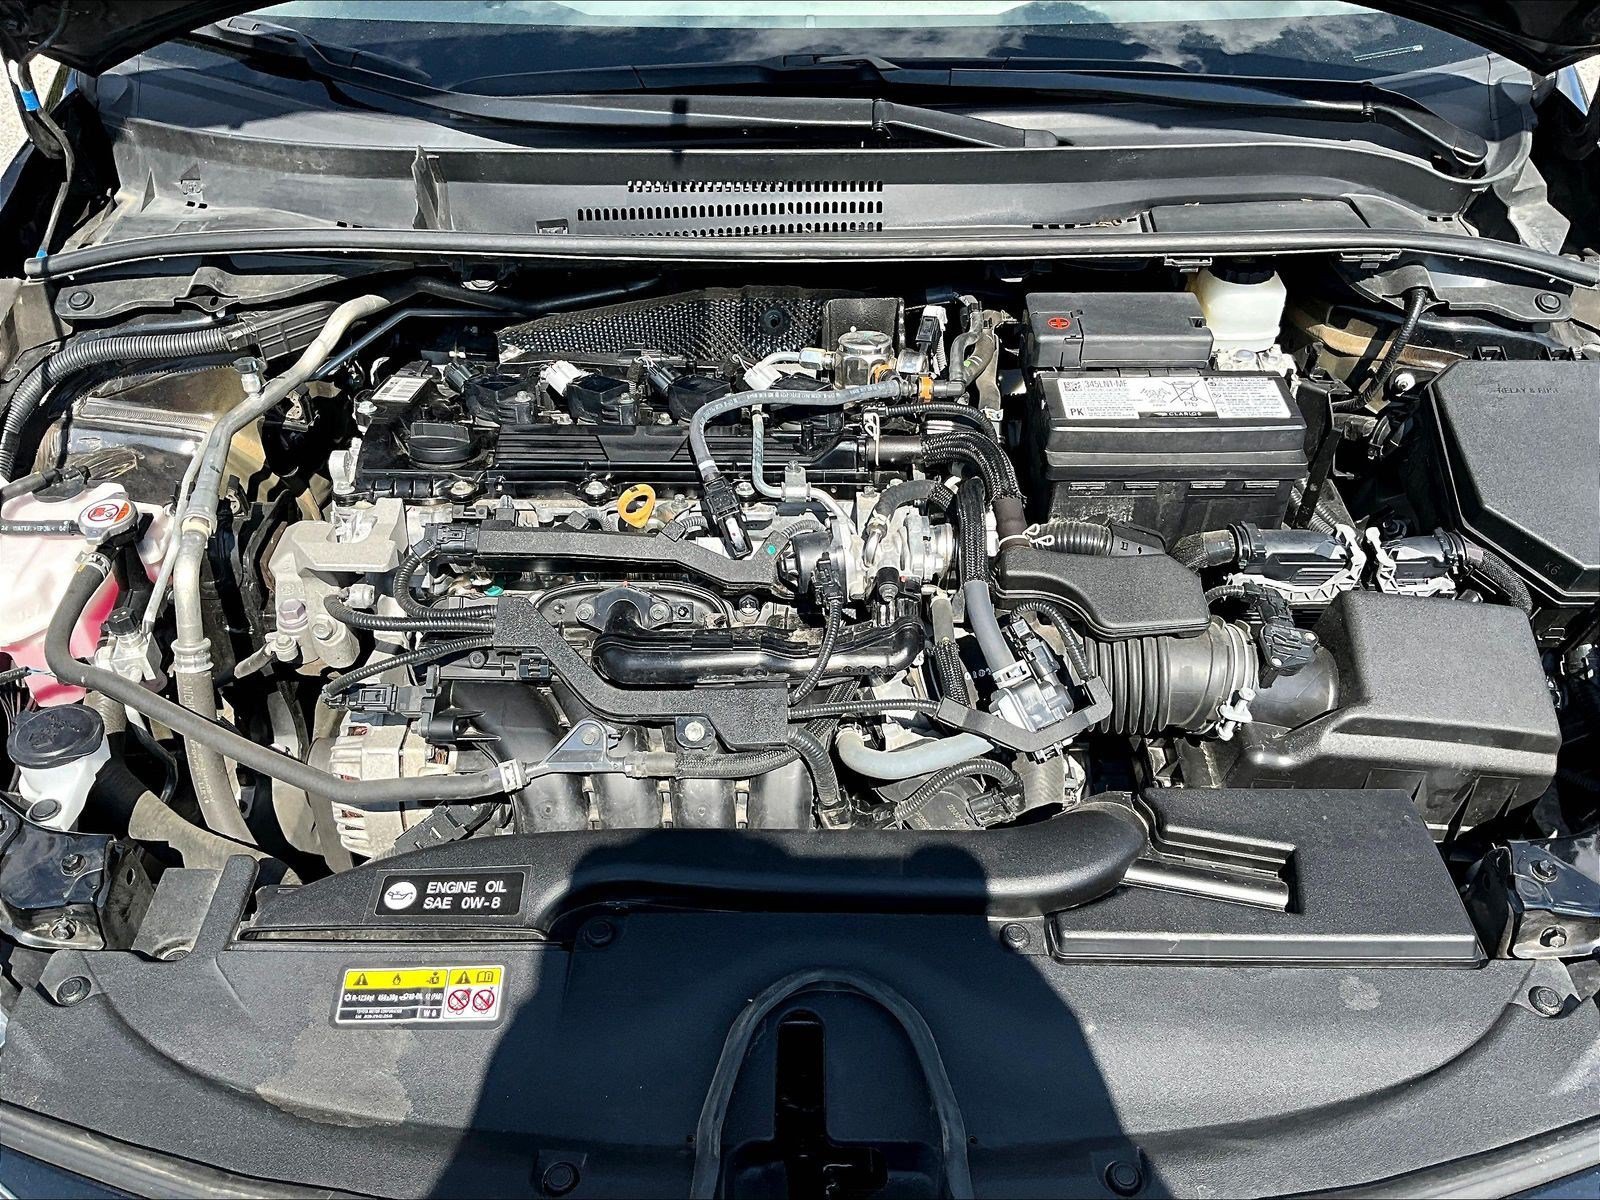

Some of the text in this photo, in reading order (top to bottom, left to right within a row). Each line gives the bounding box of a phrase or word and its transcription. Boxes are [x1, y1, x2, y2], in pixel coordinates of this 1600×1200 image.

[1070, 407, 1085, 417] PK
[426, 880, 508, 894] ENGINE OIL
[423, 896, 501, 909] SAE 0W-8
